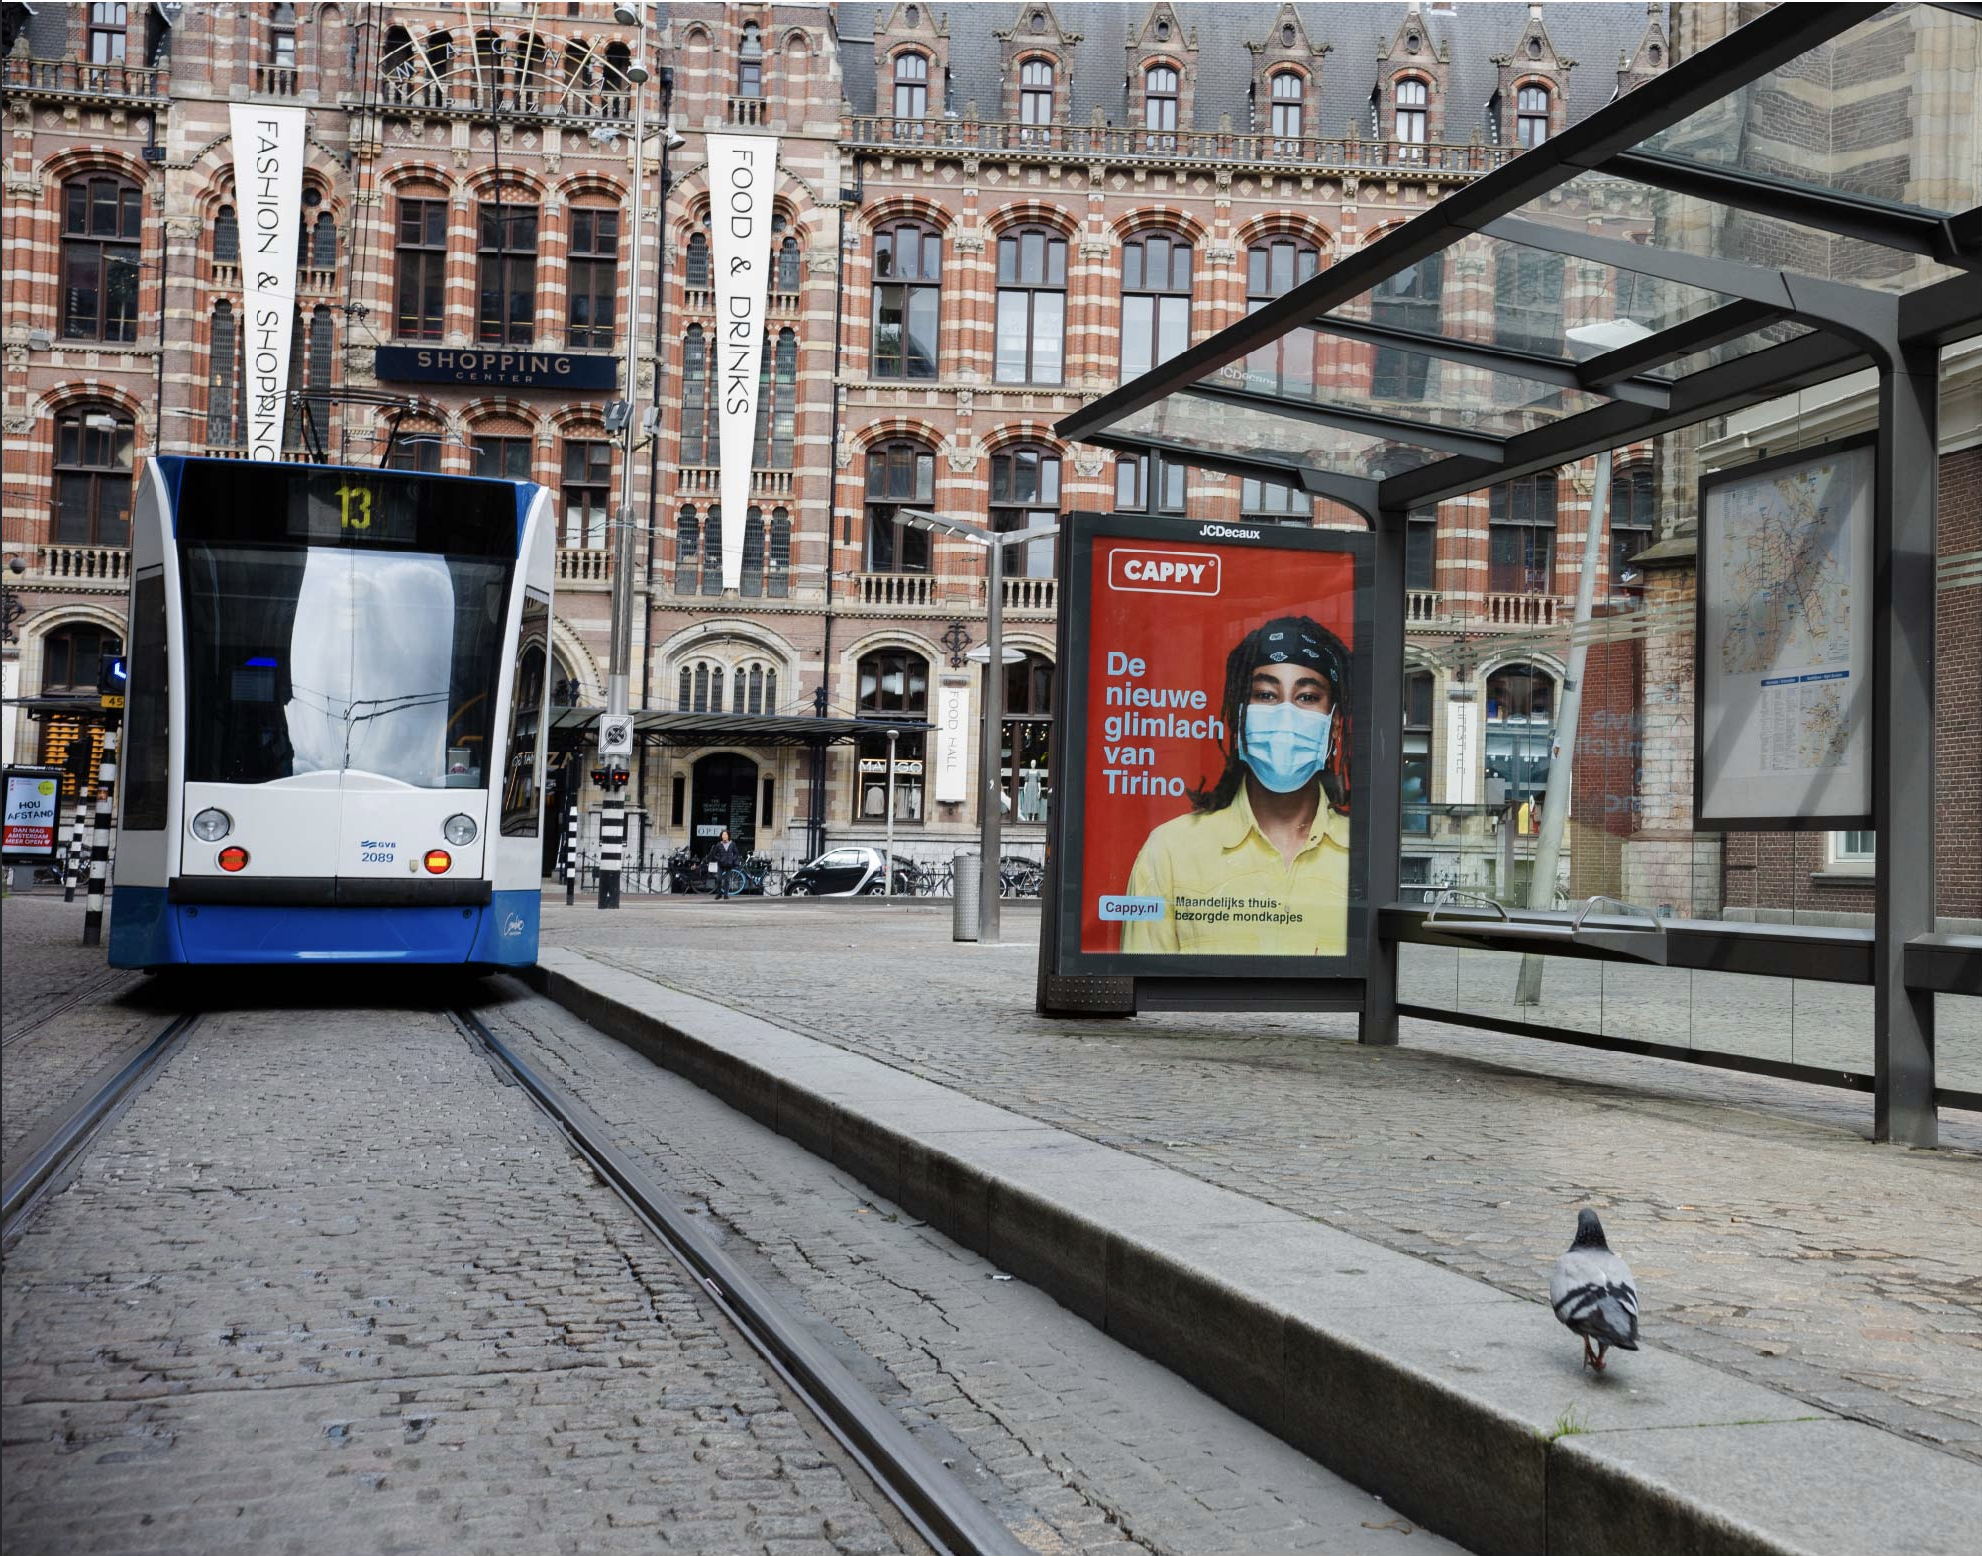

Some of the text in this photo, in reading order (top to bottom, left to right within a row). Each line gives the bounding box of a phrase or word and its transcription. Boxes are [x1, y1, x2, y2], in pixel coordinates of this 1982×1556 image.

[395, 38, 605, 96] MAGNA
[445, 98, 568, 115] PLAZA
[256, 120, 279, 253] FASHION
[257, 271, 279, 292] &
[726, 150, 754, 415] FOOD & DRINKS
[417, 351, 571, 374] SHOPPING
[456, 372, 533, 384] CENTER
[334, 487, 371, 528] 13
[1200, 524, 1260, 539] JCDecaux
[1124, 559, 1206, 584] CAPPY
[1107, 651, 1146, 677] De
[1106, 681, 1207, 709] nieuwe
[946, 691, 960, 774] FOOD HALL
[1104, 711, 1224, 742] glimlach
[1103, 746, 1155, 765] van
[1103, 769, 1185, 797] Tirino
[7, 809, 54, 820] AFSTAND
[19, 800, 41, 810] HOU
[361, 852, 394, 863] 2089
[1105, 901, 1158, 916] Cappy.nl
[1175, 896, 1282, 910] Maandelijks thuis-
[1175, 910, 1303, 925] bezorgde mondkapjes
